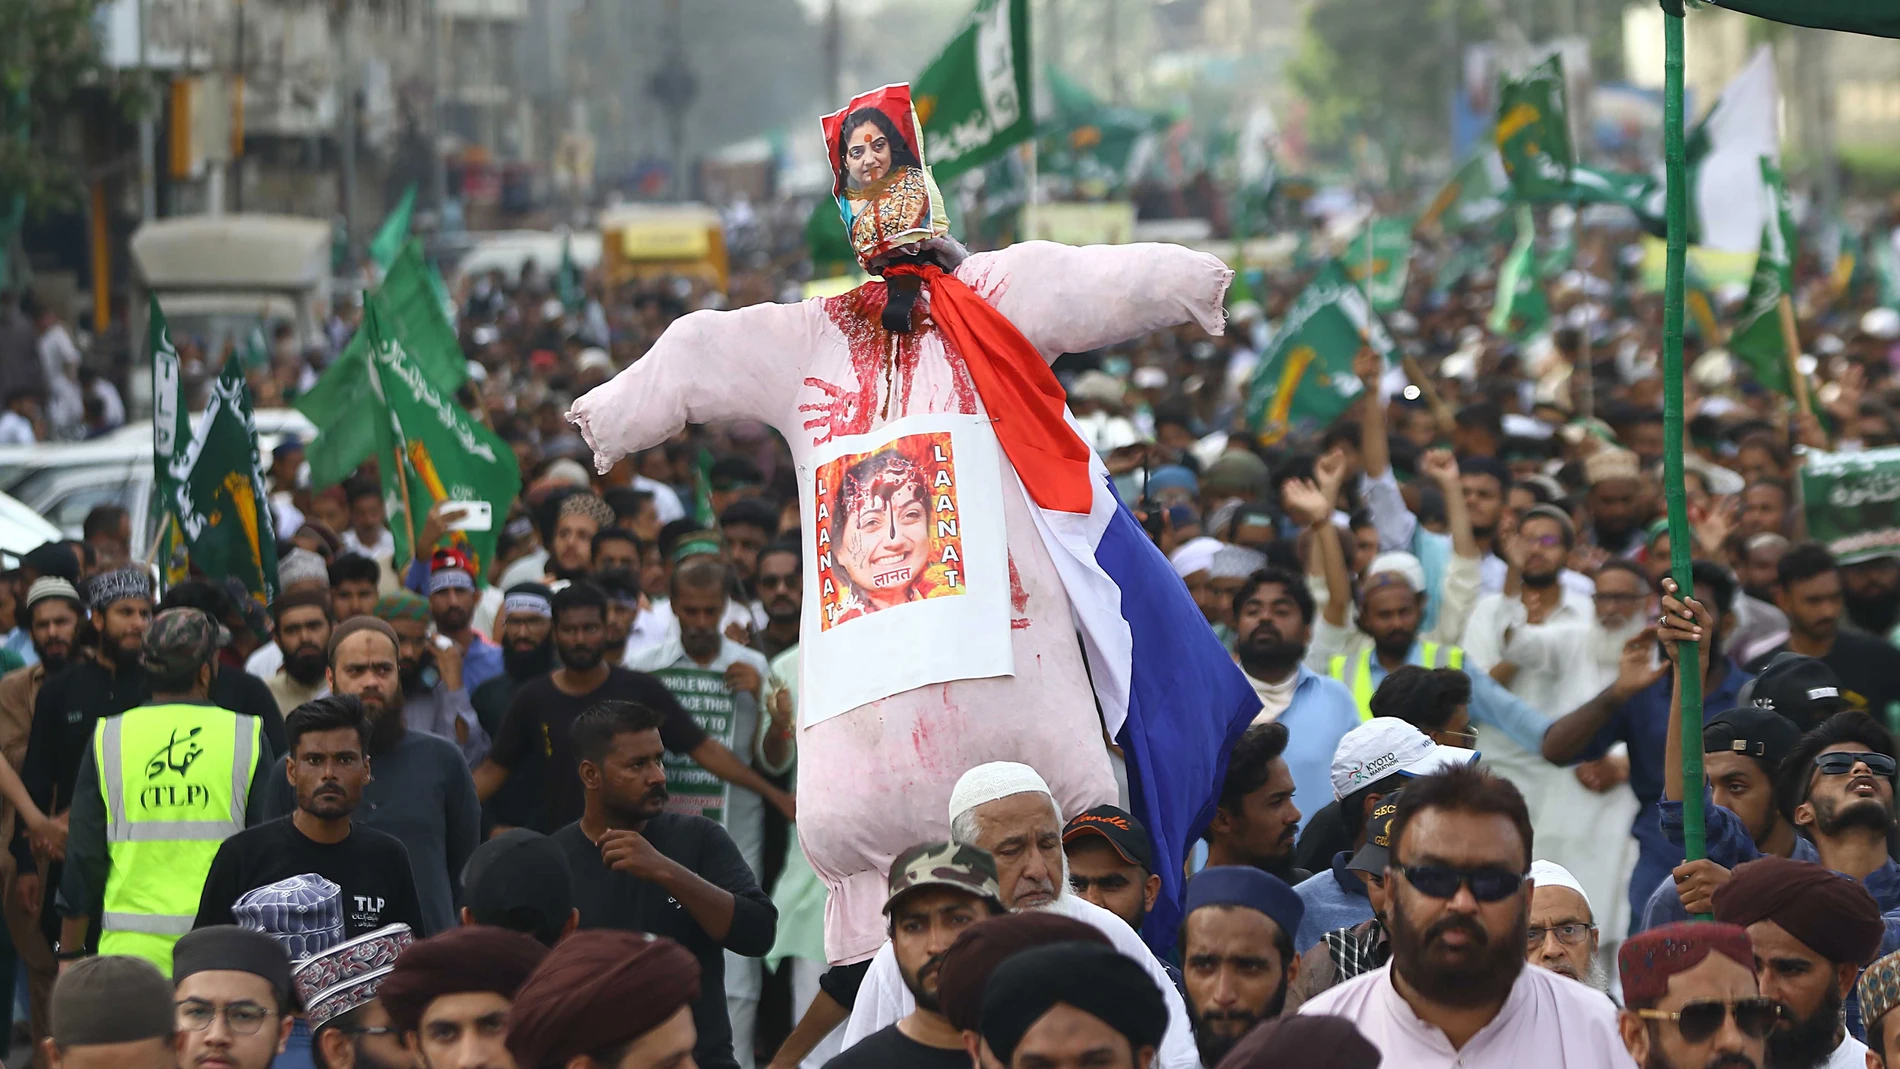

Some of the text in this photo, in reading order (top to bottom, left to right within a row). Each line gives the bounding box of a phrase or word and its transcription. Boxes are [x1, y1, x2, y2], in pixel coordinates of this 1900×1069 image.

[933, 445, 960, 587] LAANAT
[817, 479, 837, 621] LAANAT
[873, 567, 912, 588] लानत
[712, 718, 727, 732] TO
[1366, 752, 1395, 772] KYOTO
[1369, 758, 1399, 777] MARATHON
[140, 784, 210, 813] (TLP)
[353, 896, 385, 913] TLP
